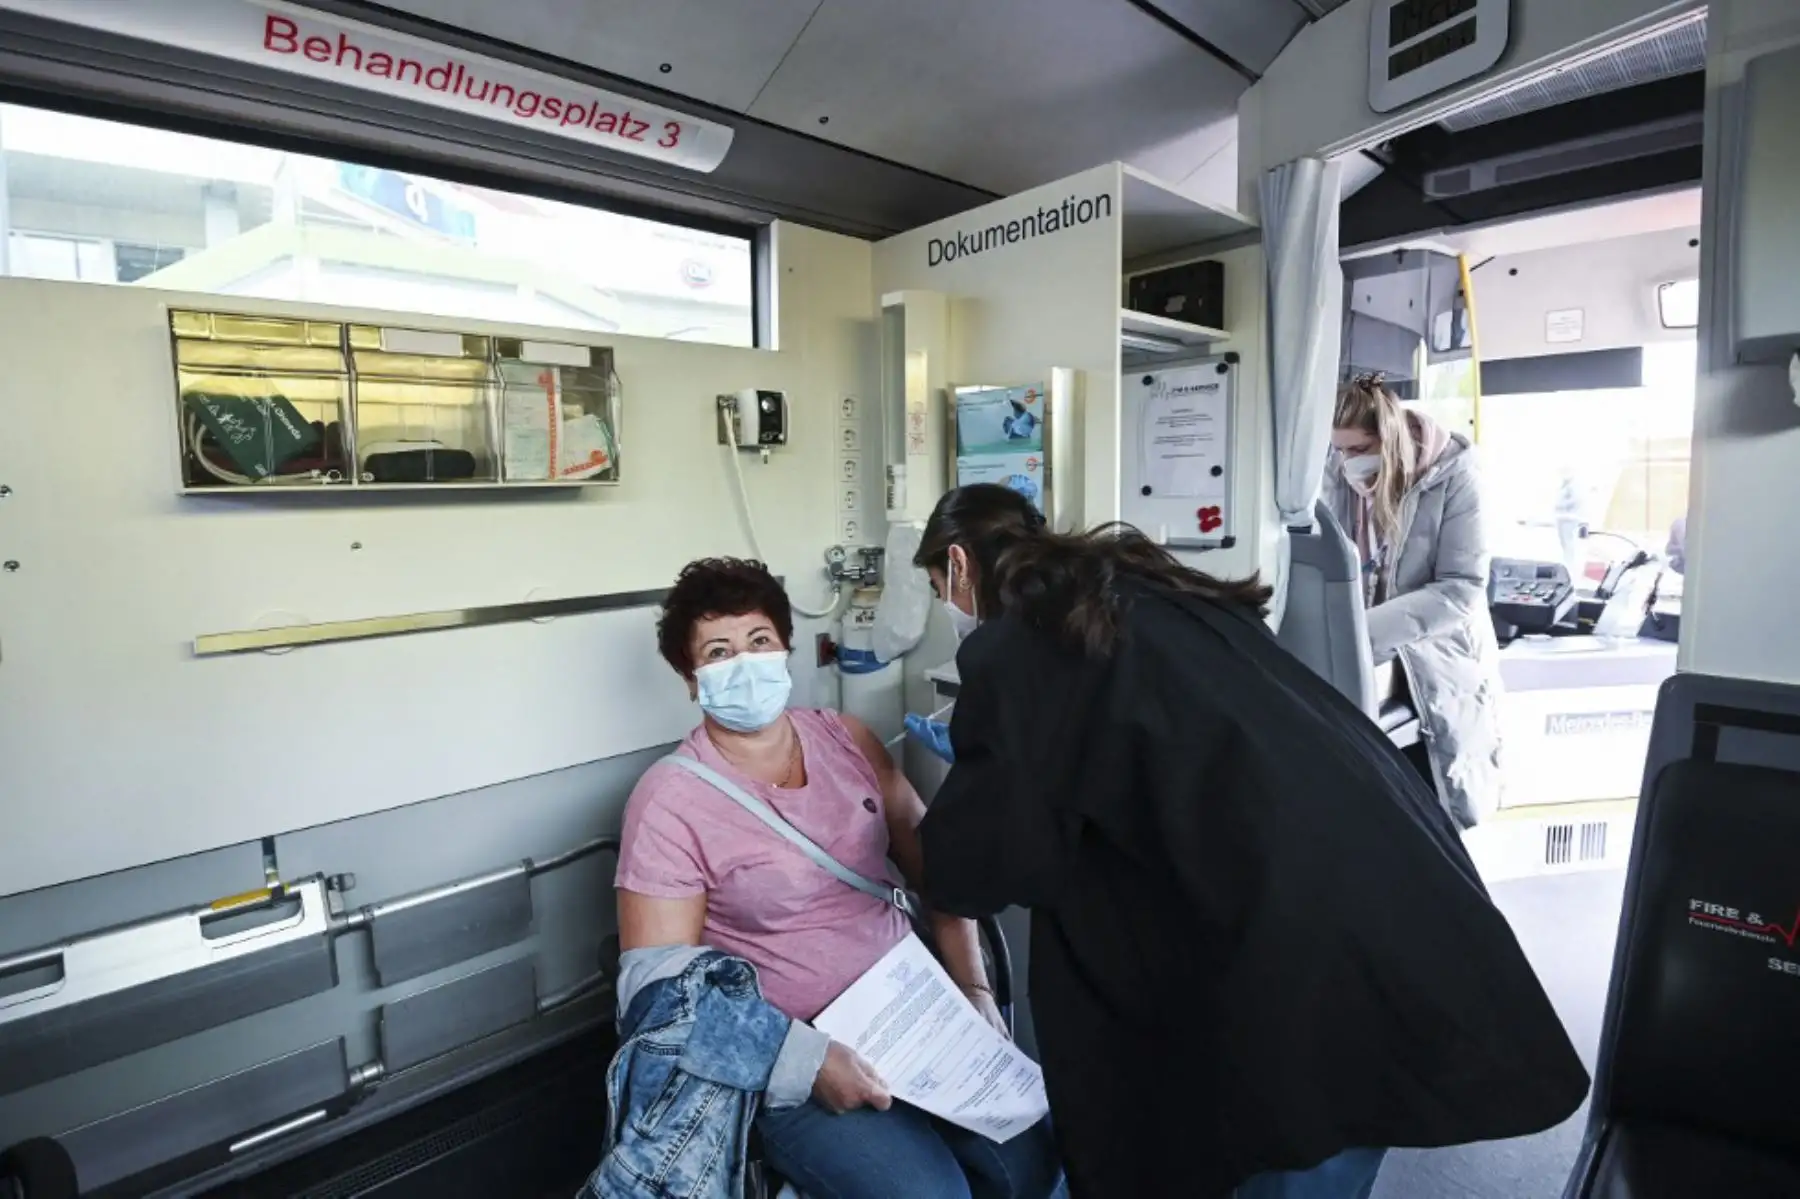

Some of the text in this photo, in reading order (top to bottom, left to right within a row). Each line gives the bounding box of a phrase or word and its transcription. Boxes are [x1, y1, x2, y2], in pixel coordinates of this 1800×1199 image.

[263, 14, 681, 149] Behandlungsplatz 3
[927, 193, 1112, 268] Dokumentation
[1688, 898, 1764, 926] FIRE &
[1767, 956, 1800, 977] SE
